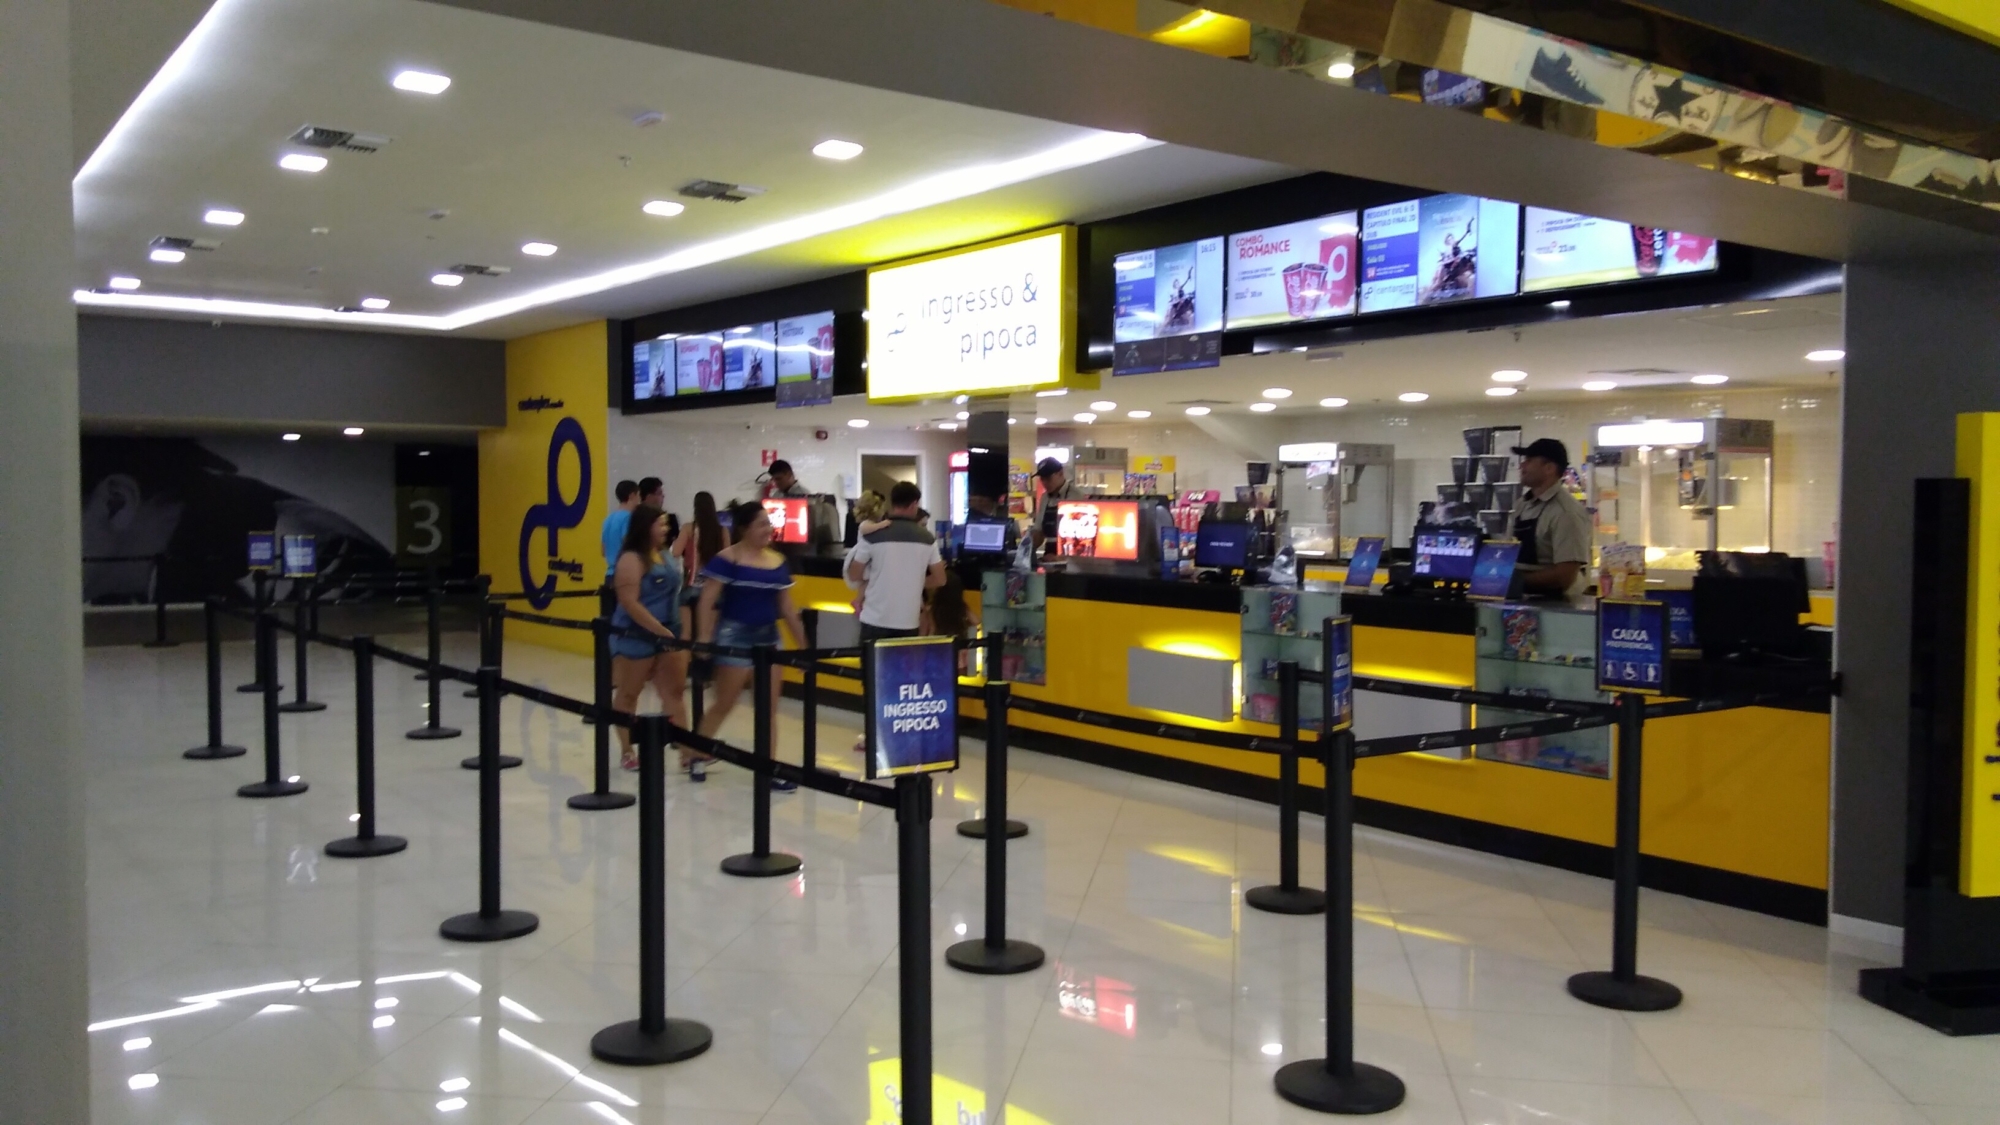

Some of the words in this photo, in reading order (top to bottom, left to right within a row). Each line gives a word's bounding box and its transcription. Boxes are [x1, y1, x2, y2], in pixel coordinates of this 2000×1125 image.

[1236, 234, 1264, 248] COMBO
[1239, 239, 1291, 260] ROMANCE
[922, 284, 1013, 325] ingresso
[1022, 272, 1039, 303] &
[960, 324, 1037, 363] pipoca
[406, 499, 443, 555] 3
[1611, 628, 1649, 642] CAIXA
[1605, 640, 1655, 651] PREFERENCIAL
[899, 682, 934, 701] FILA
[883, 699, 948, 718] INGRESSO
[892, 715, 940, 734] PIPOCA
